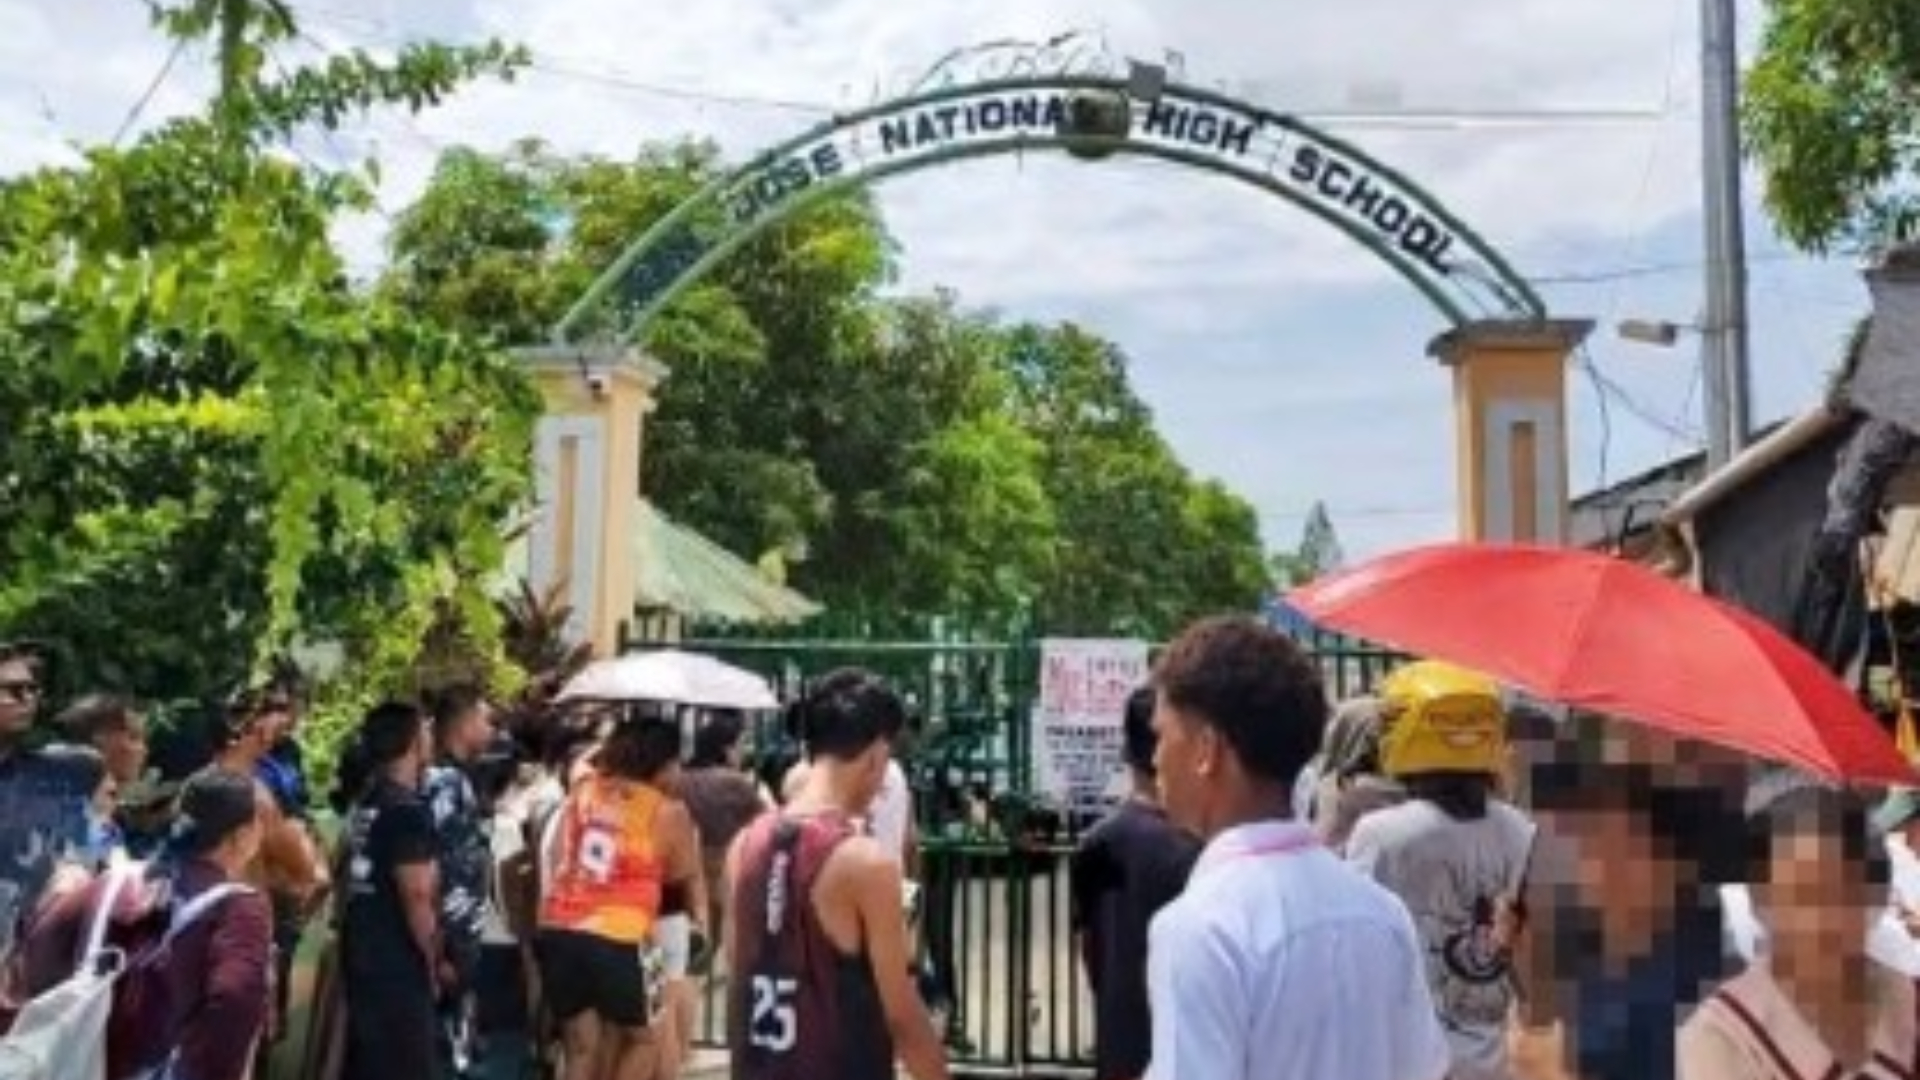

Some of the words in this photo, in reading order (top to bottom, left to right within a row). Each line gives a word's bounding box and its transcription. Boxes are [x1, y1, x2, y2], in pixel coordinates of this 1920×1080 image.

[731, 142, 844, 223] JOSE
[879, 94, 1070, 154] NATIONA
[1144, 100, 1255, 157] HIGH
[1288, 146, 1459, 276] SCHOOL
[750, 973, 798, 1052] 25
